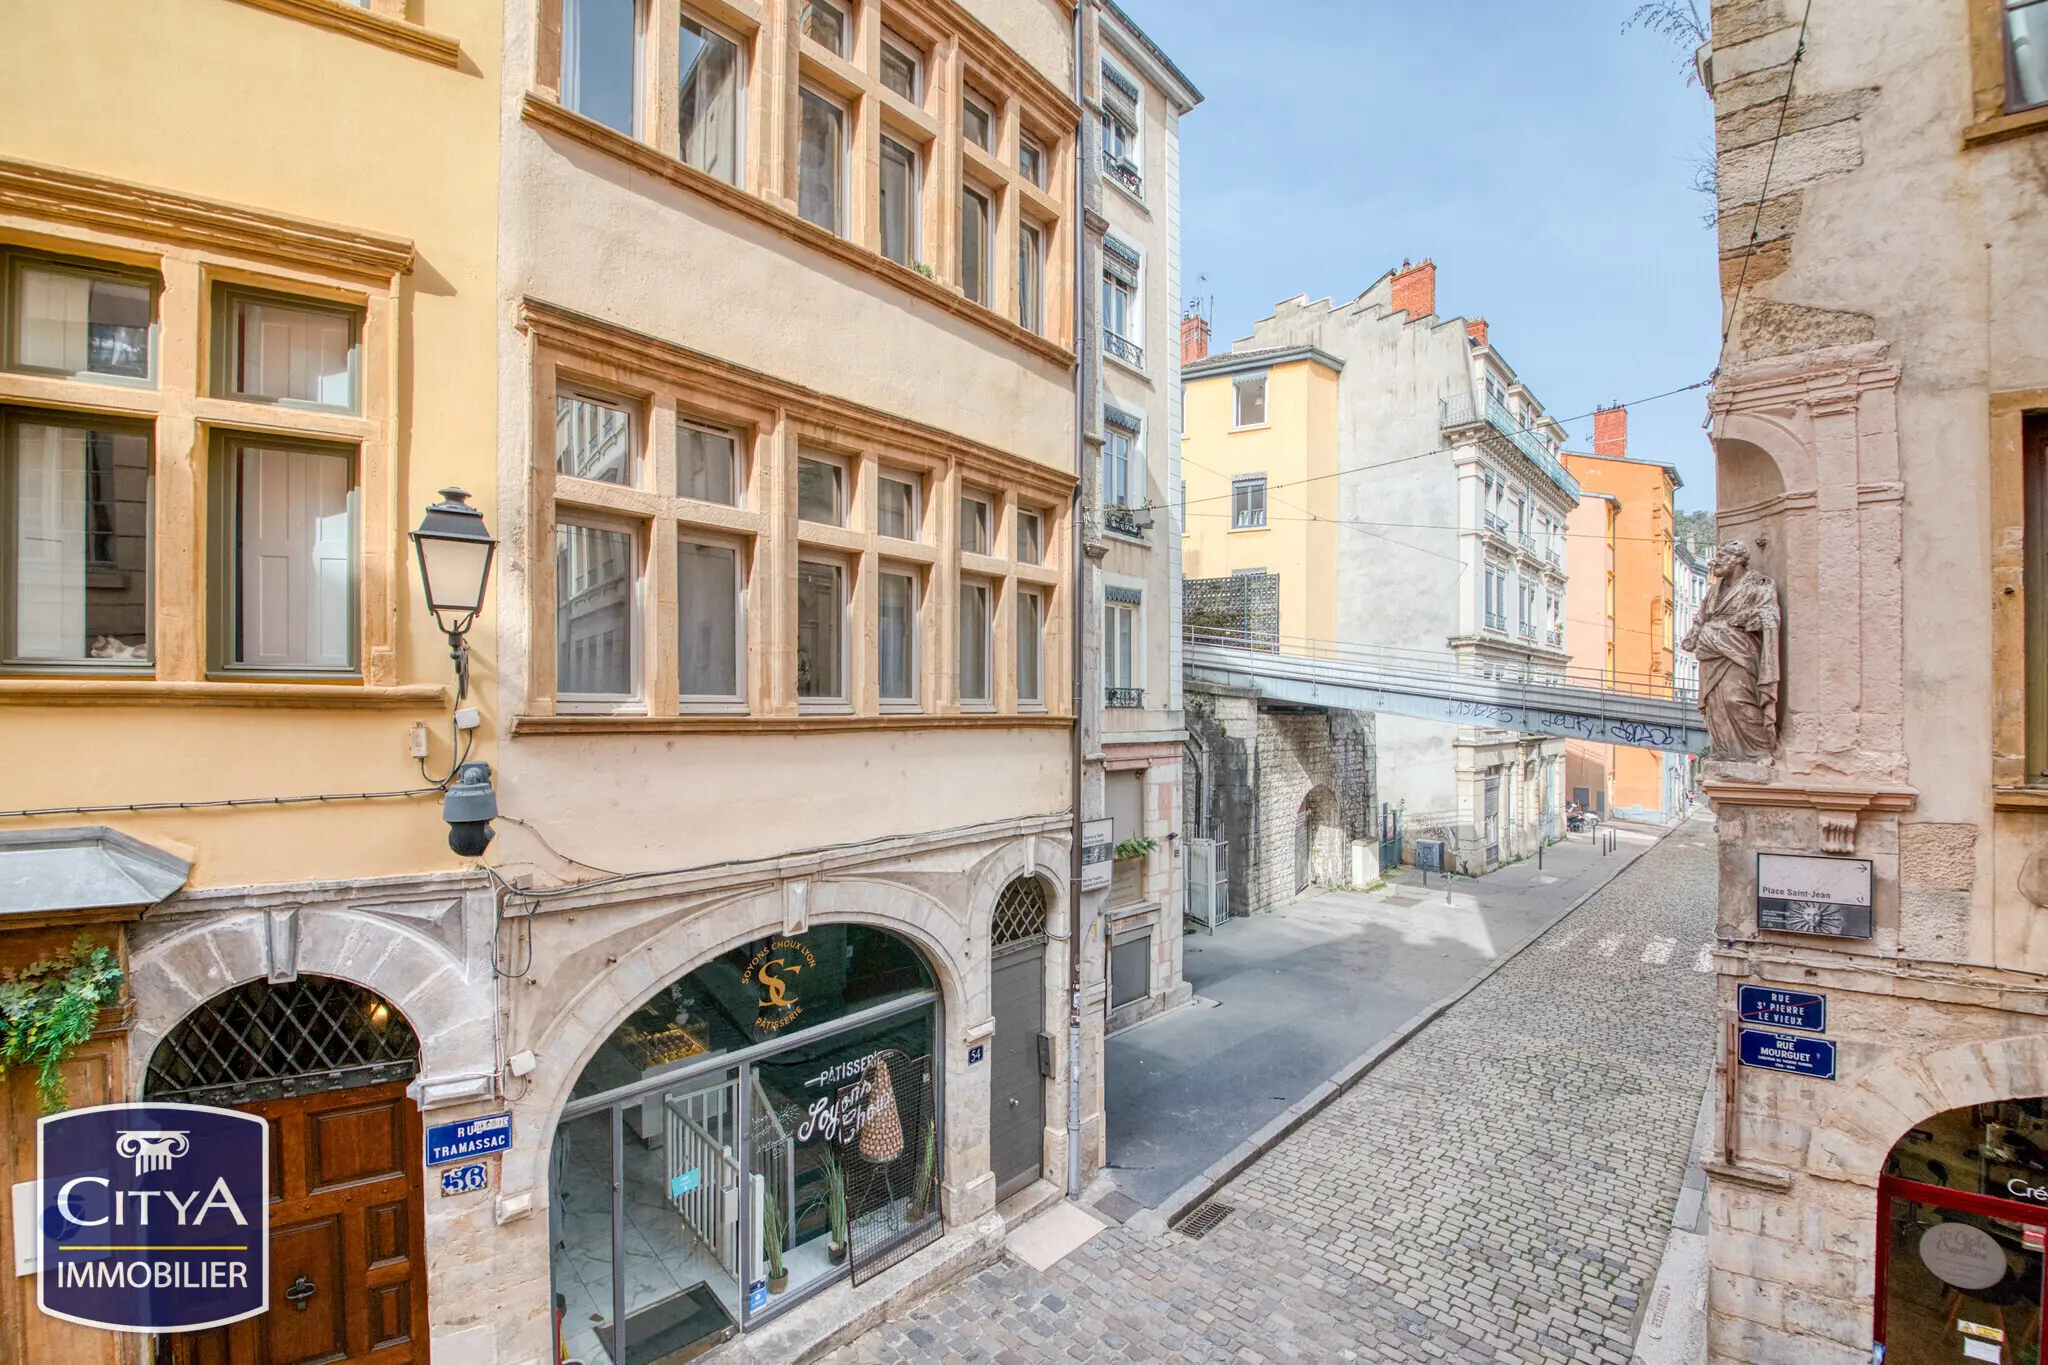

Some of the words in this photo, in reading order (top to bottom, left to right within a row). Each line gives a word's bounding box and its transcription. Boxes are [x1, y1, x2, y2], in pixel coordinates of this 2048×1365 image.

[1762, 886, 1785, 896] Place
[1786, 888, 1831, 899] Saint-Jean
[741, 946, 770, 985] SOYONS
[771, 939, 801, 951] CHOUX
[800, 945, 817, 968] LYON
[1771, 993, 1791, 1004] RUE
[1770, 1003, 1805, 1016] PIERRE
[755, 1005, 803, 1030] PÂTISSERIE
[1758, 1011, 1770, 1021] LE
[1774, 1014, 1803, 1026] VIEUX
[1776, 1040, 1795, 1051] RUE
[971, 1048, 981, 1062] 54
[1760, 1047, 1811, 1062] MOURGUET
[433, 1134, 506, 1159] TRAMASSAC
[449, 1165, 481, 1191] 56
[2007, 1178, 2048, 1201] Cré
